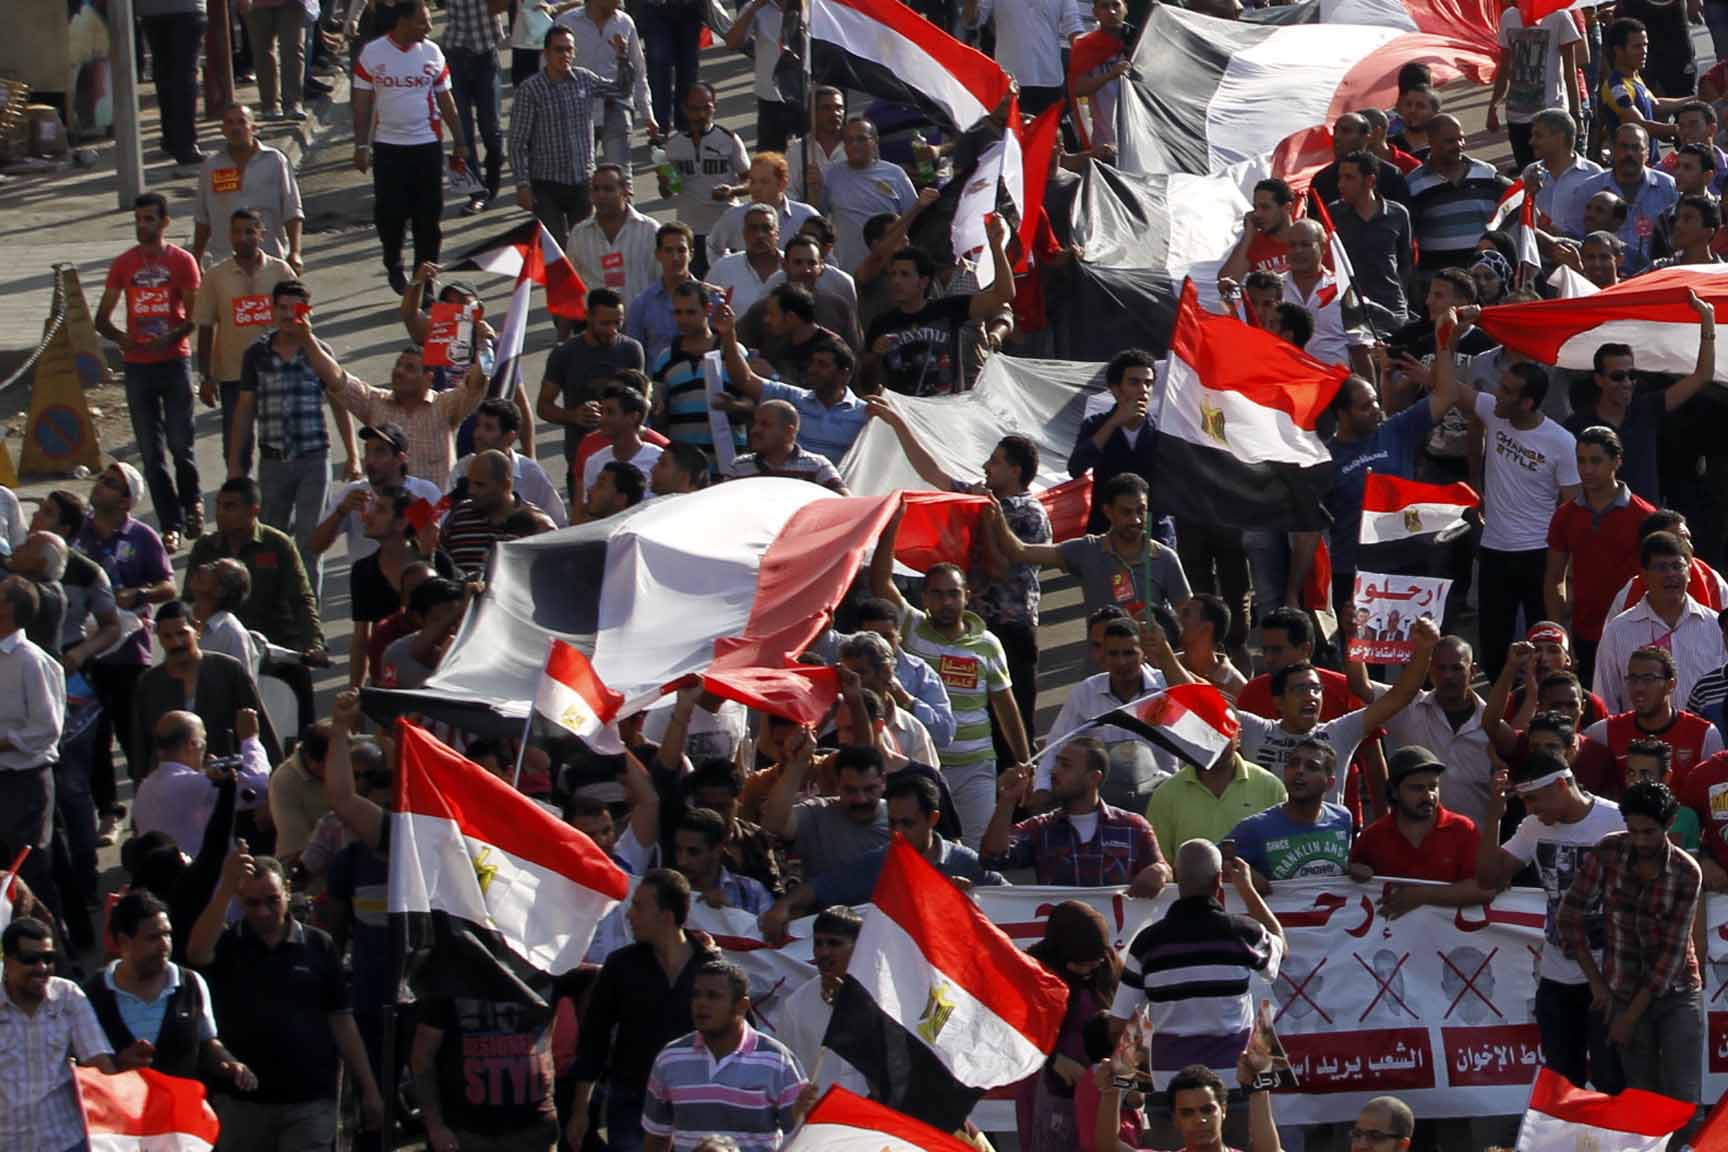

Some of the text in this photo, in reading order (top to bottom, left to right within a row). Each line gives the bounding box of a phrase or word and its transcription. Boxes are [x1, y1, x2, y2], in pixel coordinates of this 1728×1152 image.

[1355, 578, 1444, 607] ارحلوا
[1317, 1052, 1364, 1081] يريد
[1368, 1042, 1423, 1071] الشعب
[1456, 1042, 1515, 1074] الإخوان
